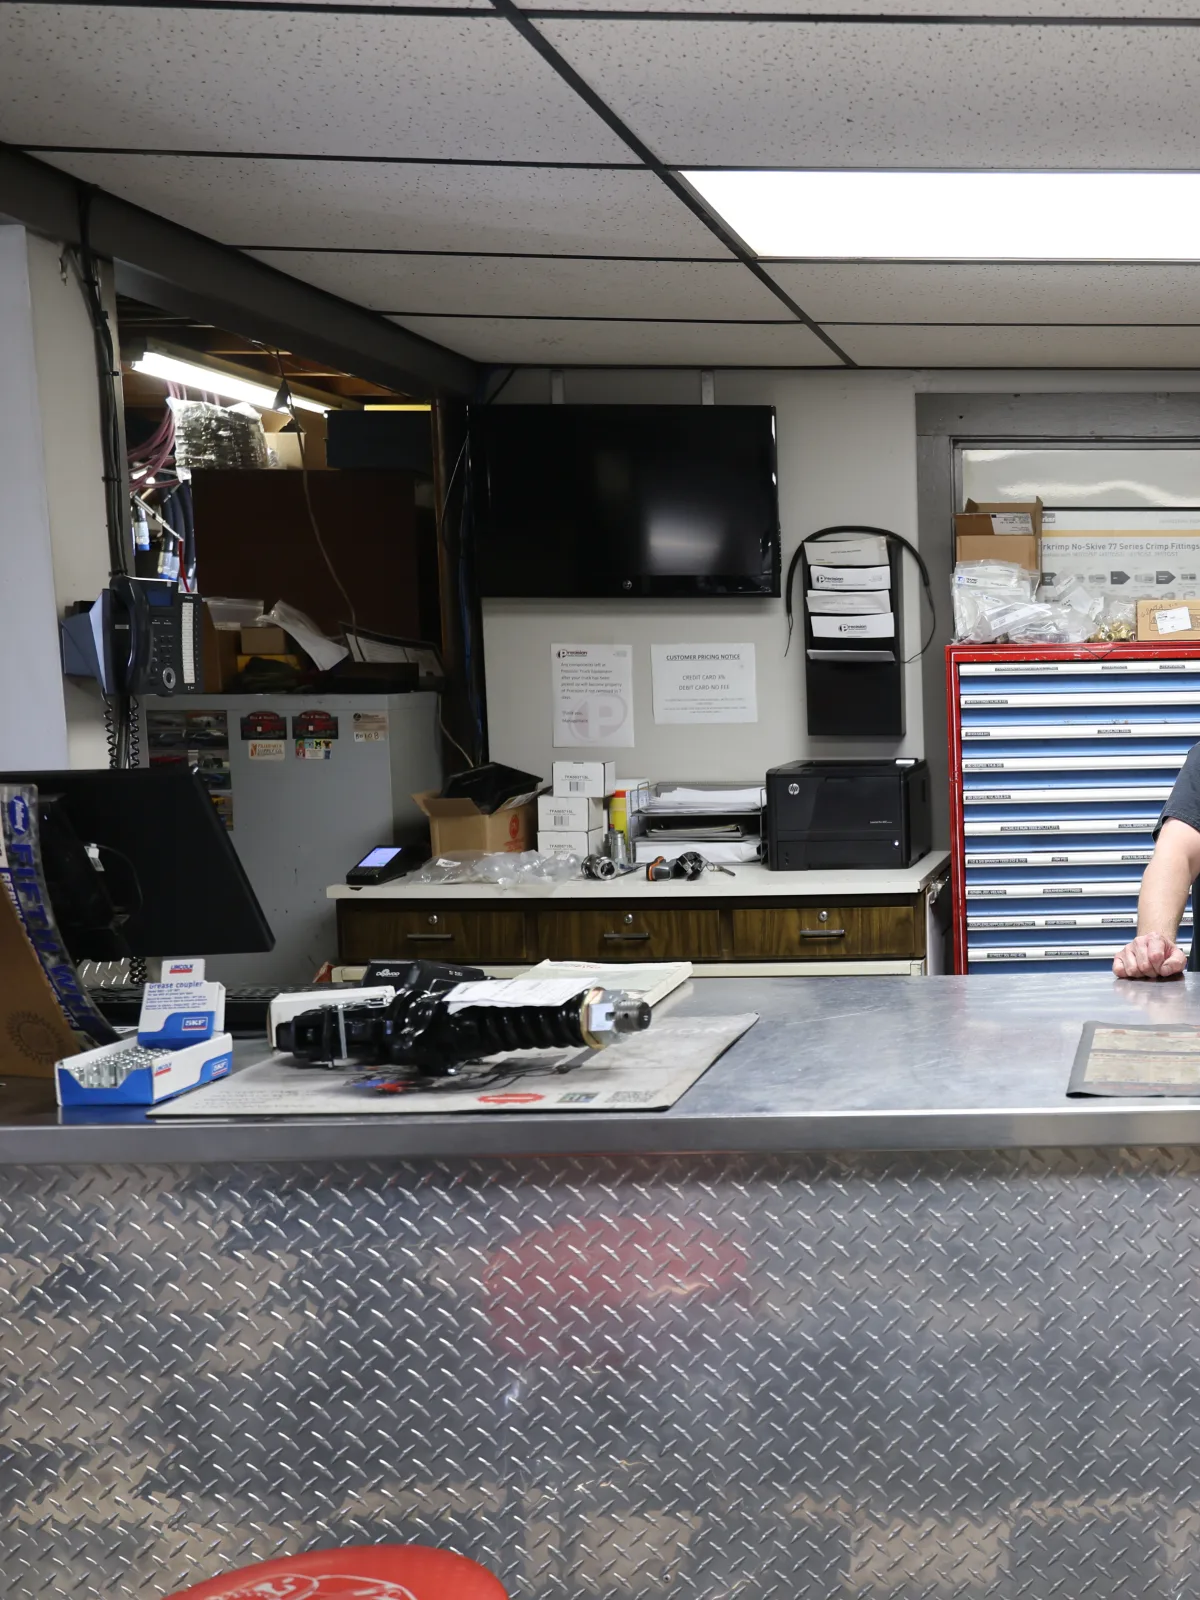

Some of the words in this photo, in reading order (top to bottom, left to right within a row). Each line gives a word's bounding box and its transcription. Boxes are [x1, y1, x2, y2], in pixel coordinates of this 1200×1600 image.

[1040, 542, 1070, 552] rkrimp
[1071, 542, 1106, 551] No-Skive
[1108, 542, 1117, 550] 77
[1119, 542, 1144, 550] Series
[1145, 542, 1169, 552] Crimp
[1170, 542, 1200, 553] Fittings
[789, 783, 799, 796] hp
[176, 980, 204, 989] coupler
